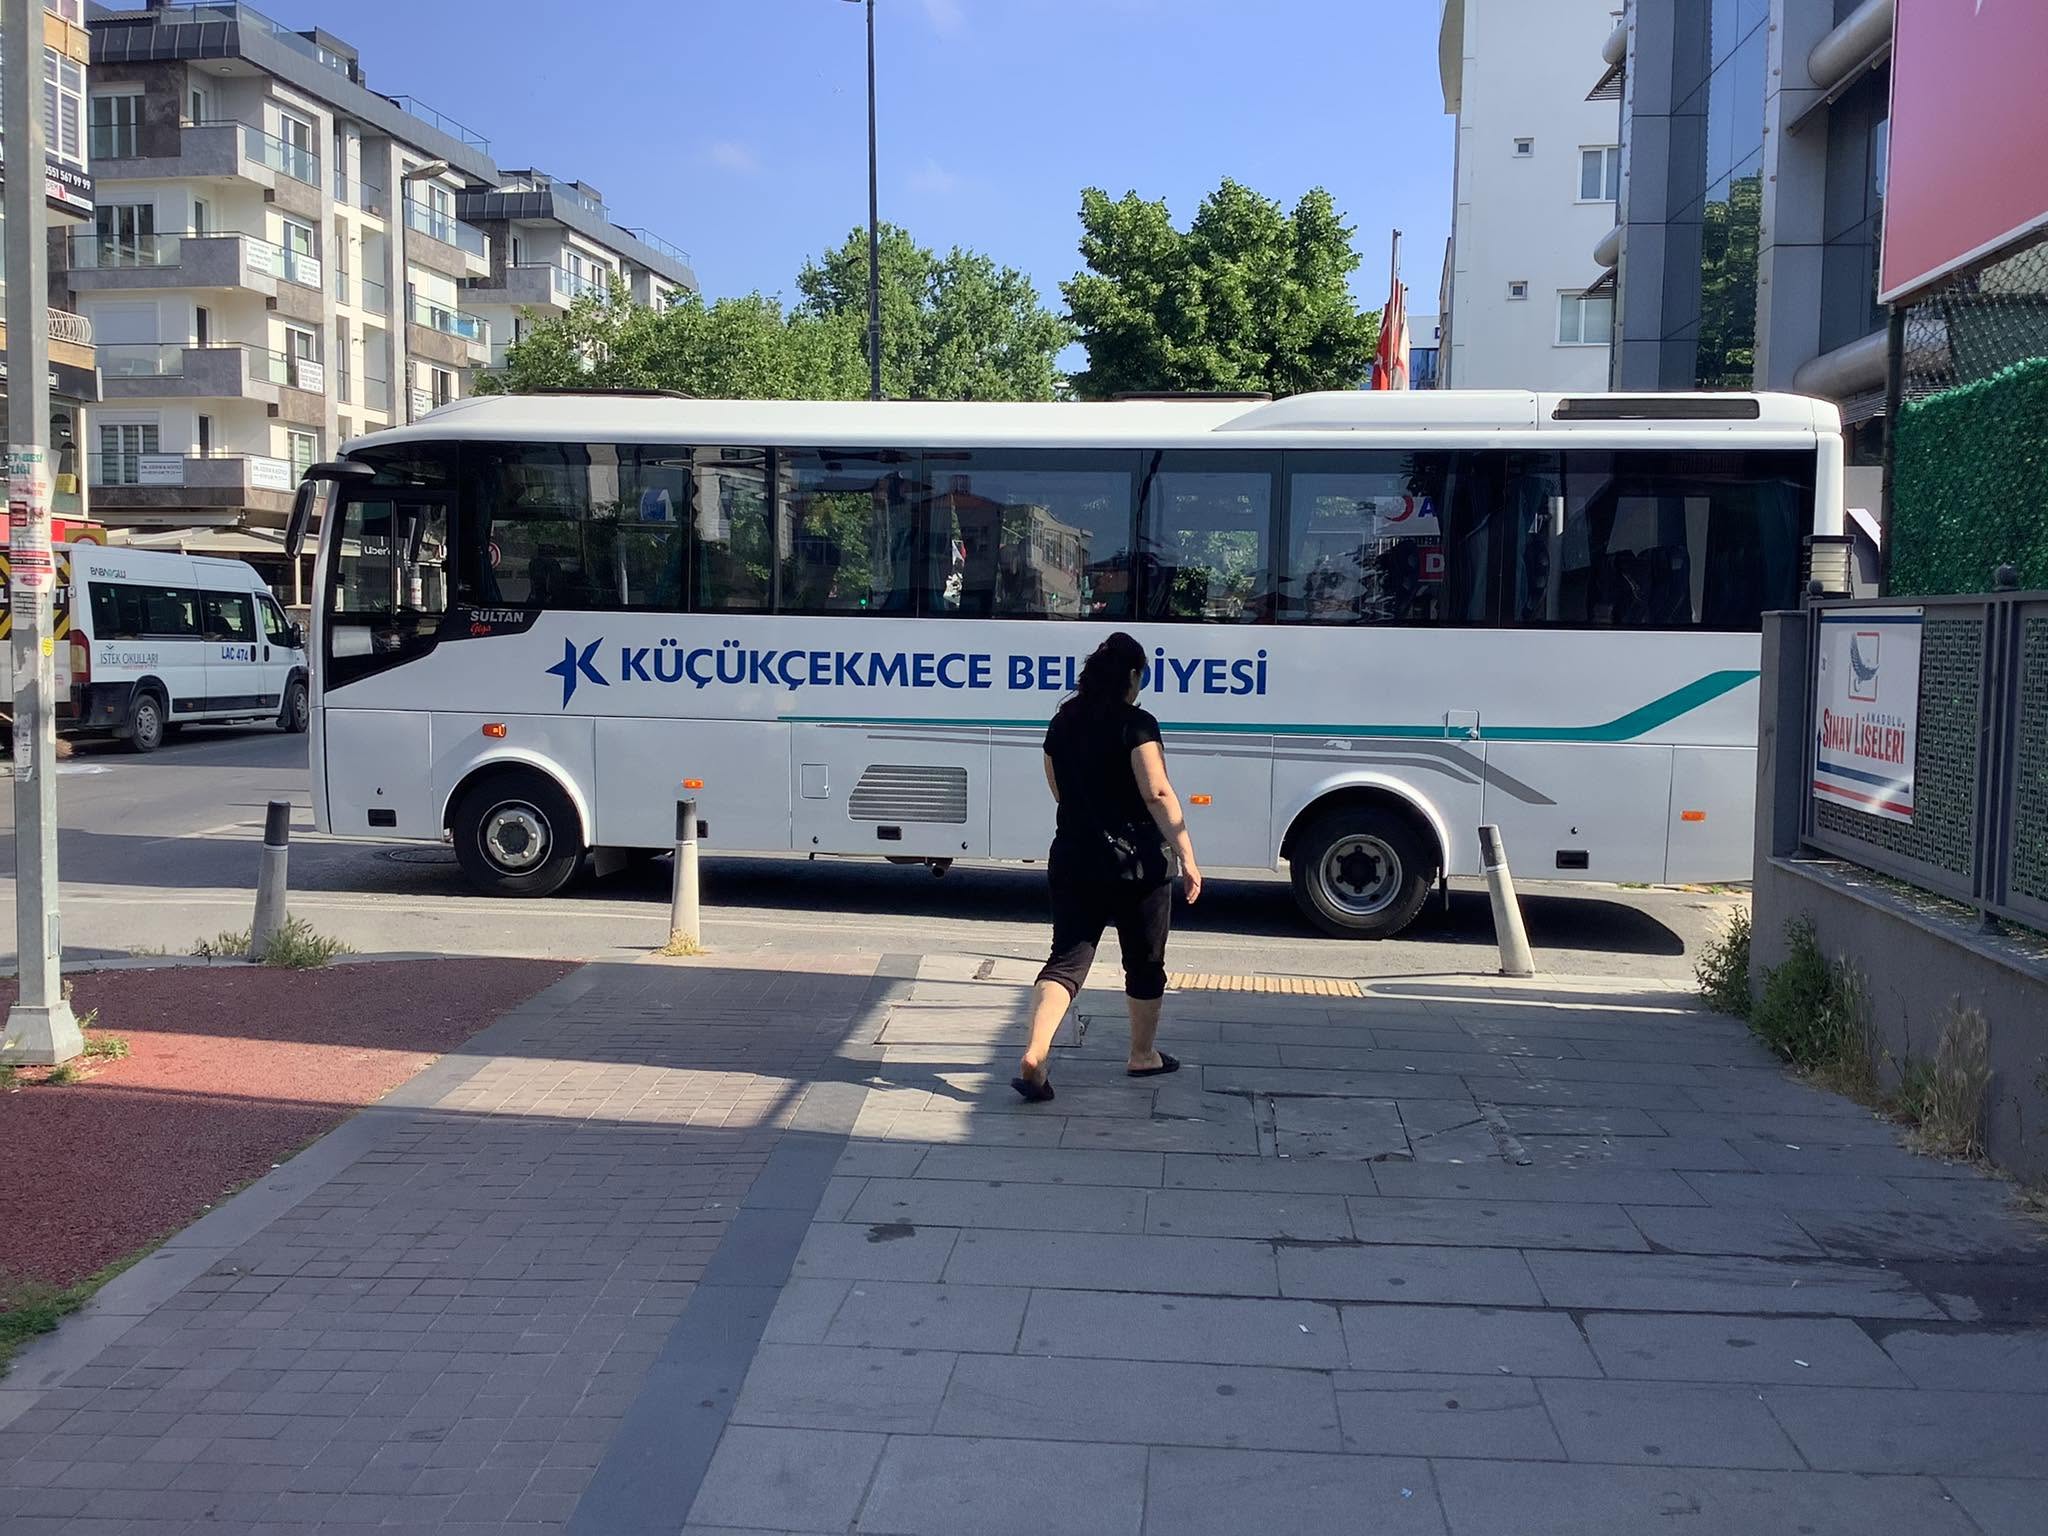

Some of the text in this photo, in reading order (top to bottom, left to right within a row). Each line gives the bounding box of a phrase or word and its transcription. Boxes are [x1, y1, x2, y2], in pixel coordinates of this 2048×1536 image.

[60, 170, 72, 183] 567
[73, 175, 82, 187] 99
[82, 178, 91, 190] 99
[470, 610, 524, 623] SULTAN
[236, 648, 249, 661] 474
[622, 638, 1267, 695] KÜÇÜKÇEKMECE BELİYESİ
[1823, 707, 1905, 764] SINAV LİSELERİ
